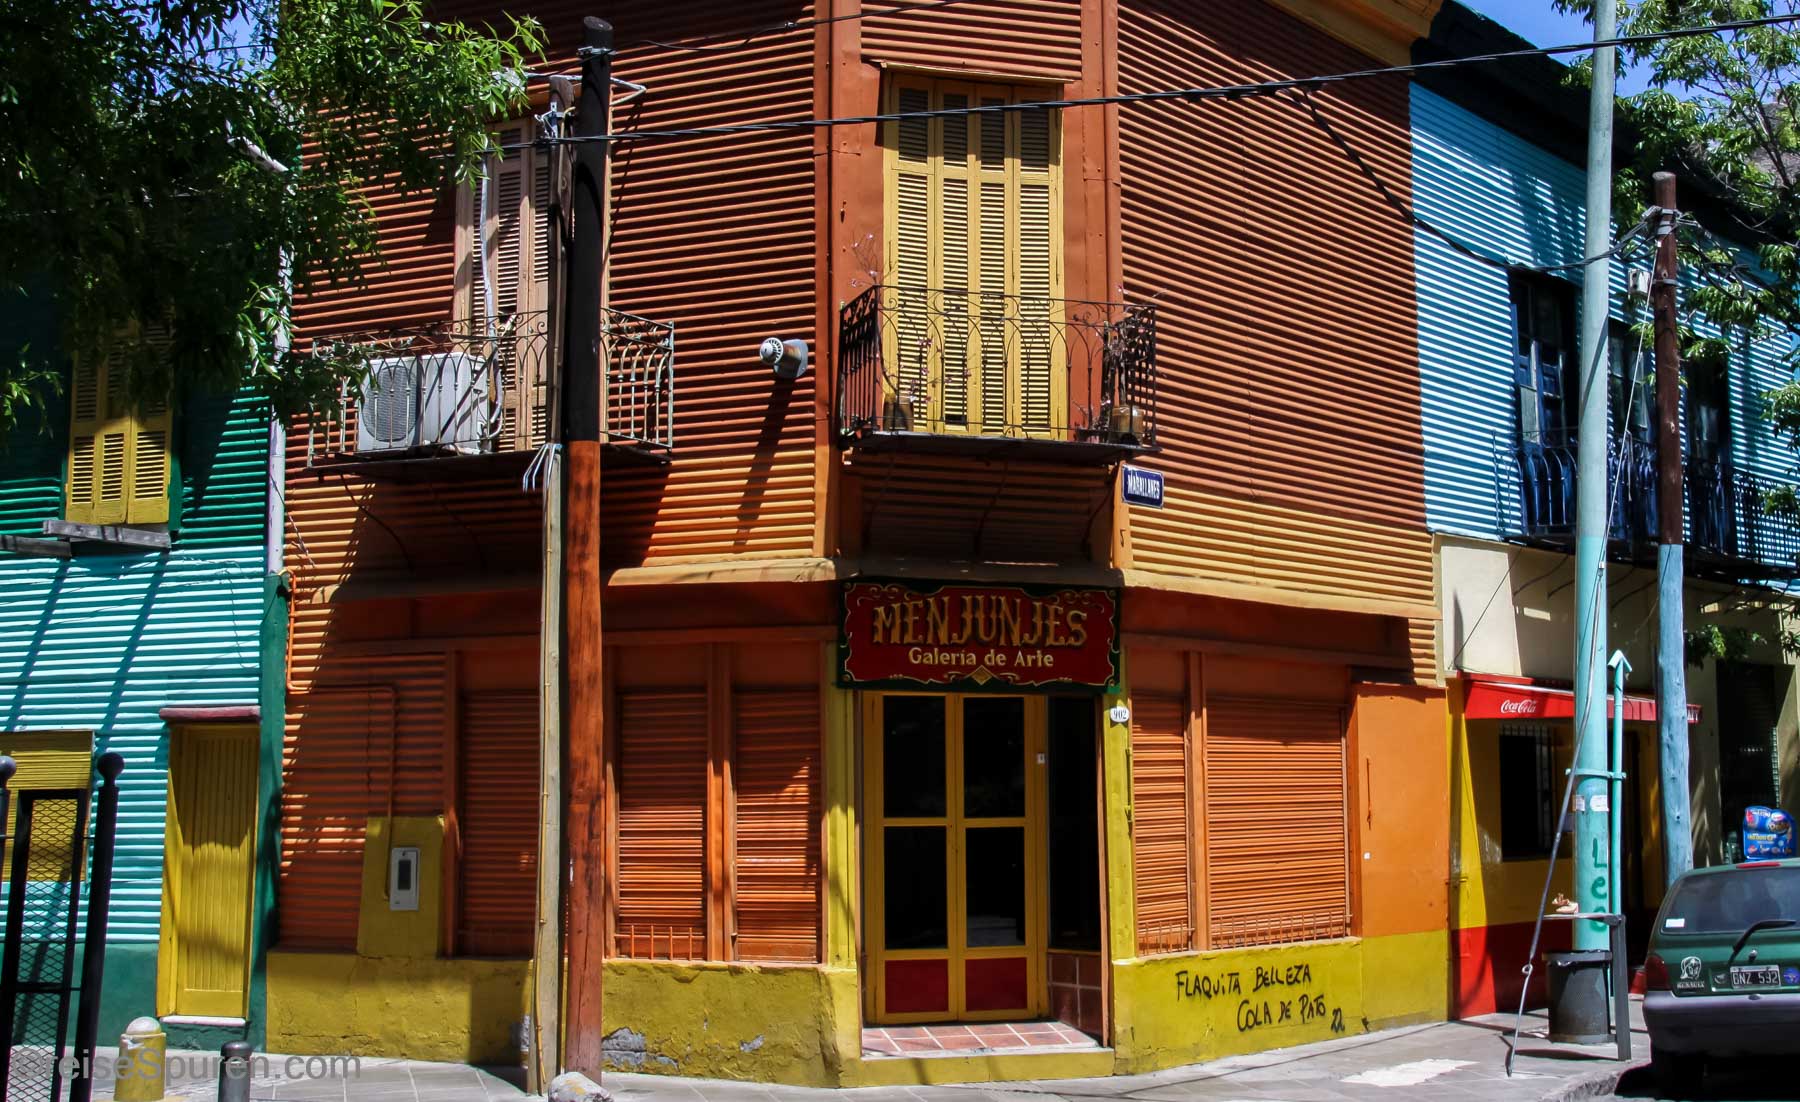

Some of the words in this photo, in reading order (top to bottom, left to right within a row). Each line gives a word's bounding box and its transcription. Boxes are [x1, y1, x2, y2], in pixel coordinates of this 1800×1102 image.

[872, 594, 1088, 647] MENJUNJES
[984, 647, 1007, 666] de
[1014, 650, 1054, 668] Arte
[1113, 709, 1127, 720] 902
[1732, 972, 1753, 985] GNZ
[1757, 971, 1778, 984] 592
[1236, 999, 1272, 1032] COLA
[1278, 1000, 1292, 1023] DE
